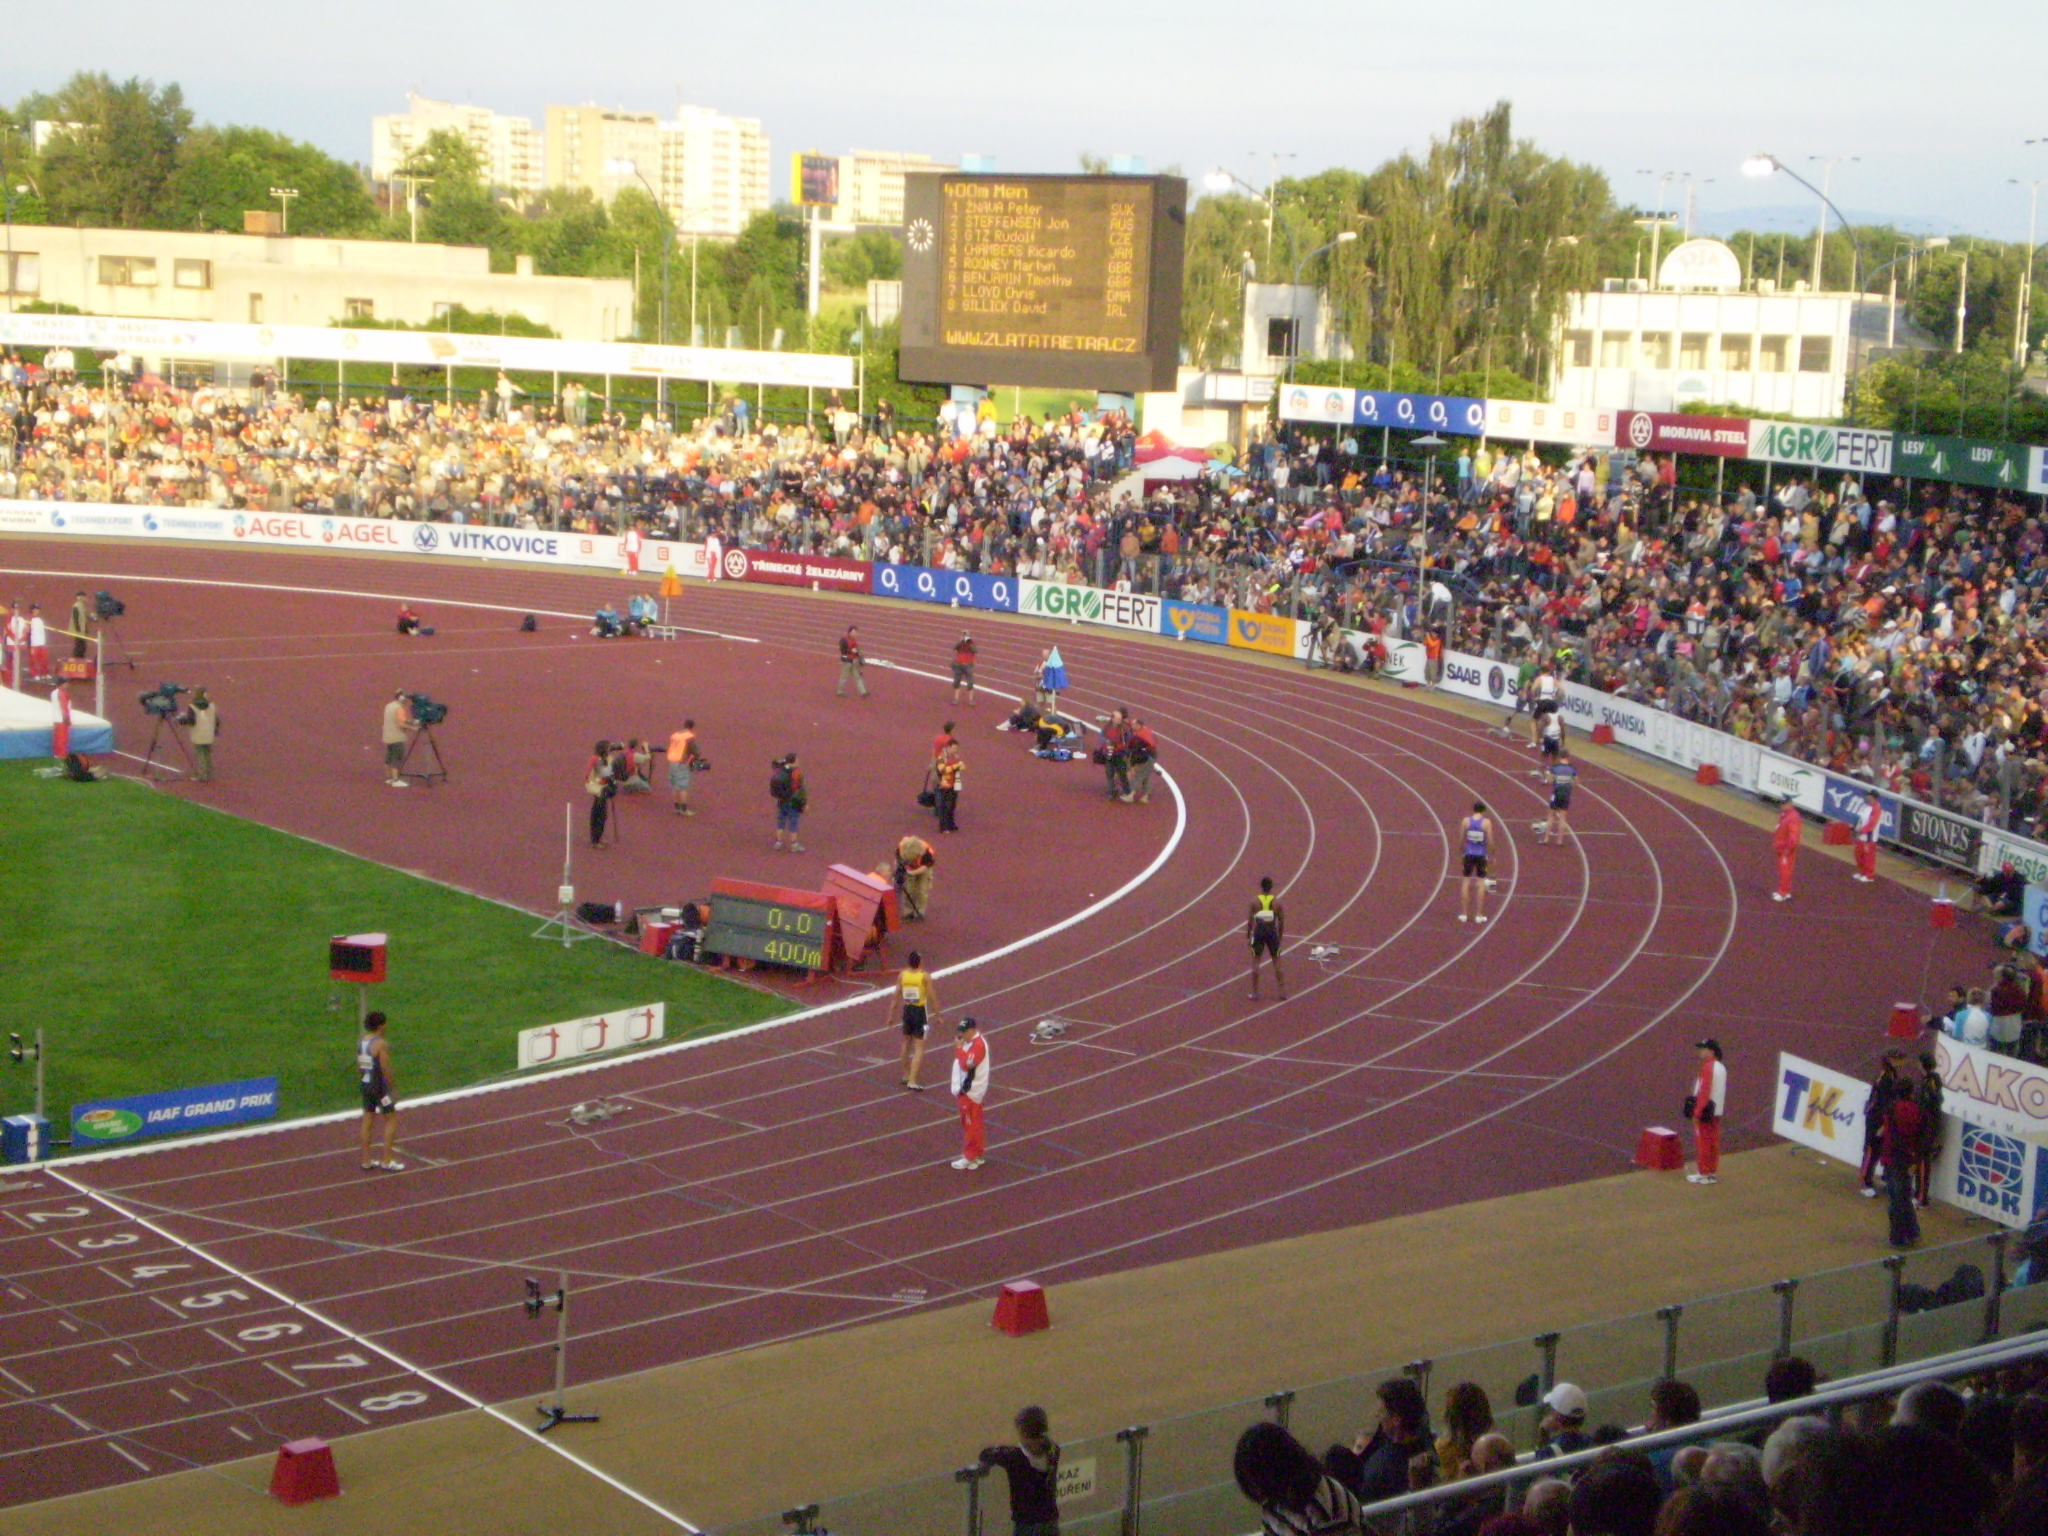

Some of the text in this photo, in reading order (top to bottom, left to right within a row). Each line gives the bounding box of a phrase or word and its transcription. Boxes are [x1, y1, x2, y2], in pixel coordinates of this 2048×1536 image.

[944, 182, 1028, 199] 400m Men
[953, 201, 958, 212] 1
[1008, 201, 1042, 214] Peter
[950, 215, 958, 228] 2
[965, 215, 1041, 228] STEFFENSEN
[1047, 217, 1069, 230] Jon
[950, 229, 958, 241] 3
[994, 229, 1035, 243] Rudolf
[1108, 232, 1132, 245] CZE
[948, 243, 1133, 259] 4 CHAMBERS Ricardo JAM
[948, 256, 1132, 274] 5 ROONEY Martyn GBR
[948, 270, 1132, 288] 6 BENJAMIN Timothy GBR
[947, 284, 956, 297] 7
[962, 285, 1000, 298] LLOYD
[1005, 286, 1036, 299] Chris
[947, 298, 1127, 317] 8 GILLICK David IRL
[1659, 425, 1747, 445] MORAVIA STEEL
[1752, 424, 1892, 469] AGROFERT
[1901, 440, 1925, 455] LESY
[1971, 447, 1993, 462] LESY
[249, 518, 312, 540] AGEL
[336, 524, 399, 545] AGEL
[1020, 583, 1158, 629] AGROFERT
[1447, 663, 1481, 686] SAAB
[1560, 694, 1594, 718] ANSKA
[1601, 707, 1646, 736] SKANSKA
[1911, 810, 1969, 851] STONES
[768, 907, 812, 935] 0.0
[763, 938, 822, 968] 400m
[147, 1092, 274, 1123] IAAF GRAND PRIX
[1957, 1173, 2021, 1216] DDK
[26, 1206, 90, 1223] 2
[78, 1233, 139, 1250] 3
[133, 1263, 192, 1279] 4
[180, 1288, 249, 1309] 5
[237, 1322, 303, 1342] 6
[291, 1352, 369, 1370] 7
[360, 1390, 428, 1412] 8
